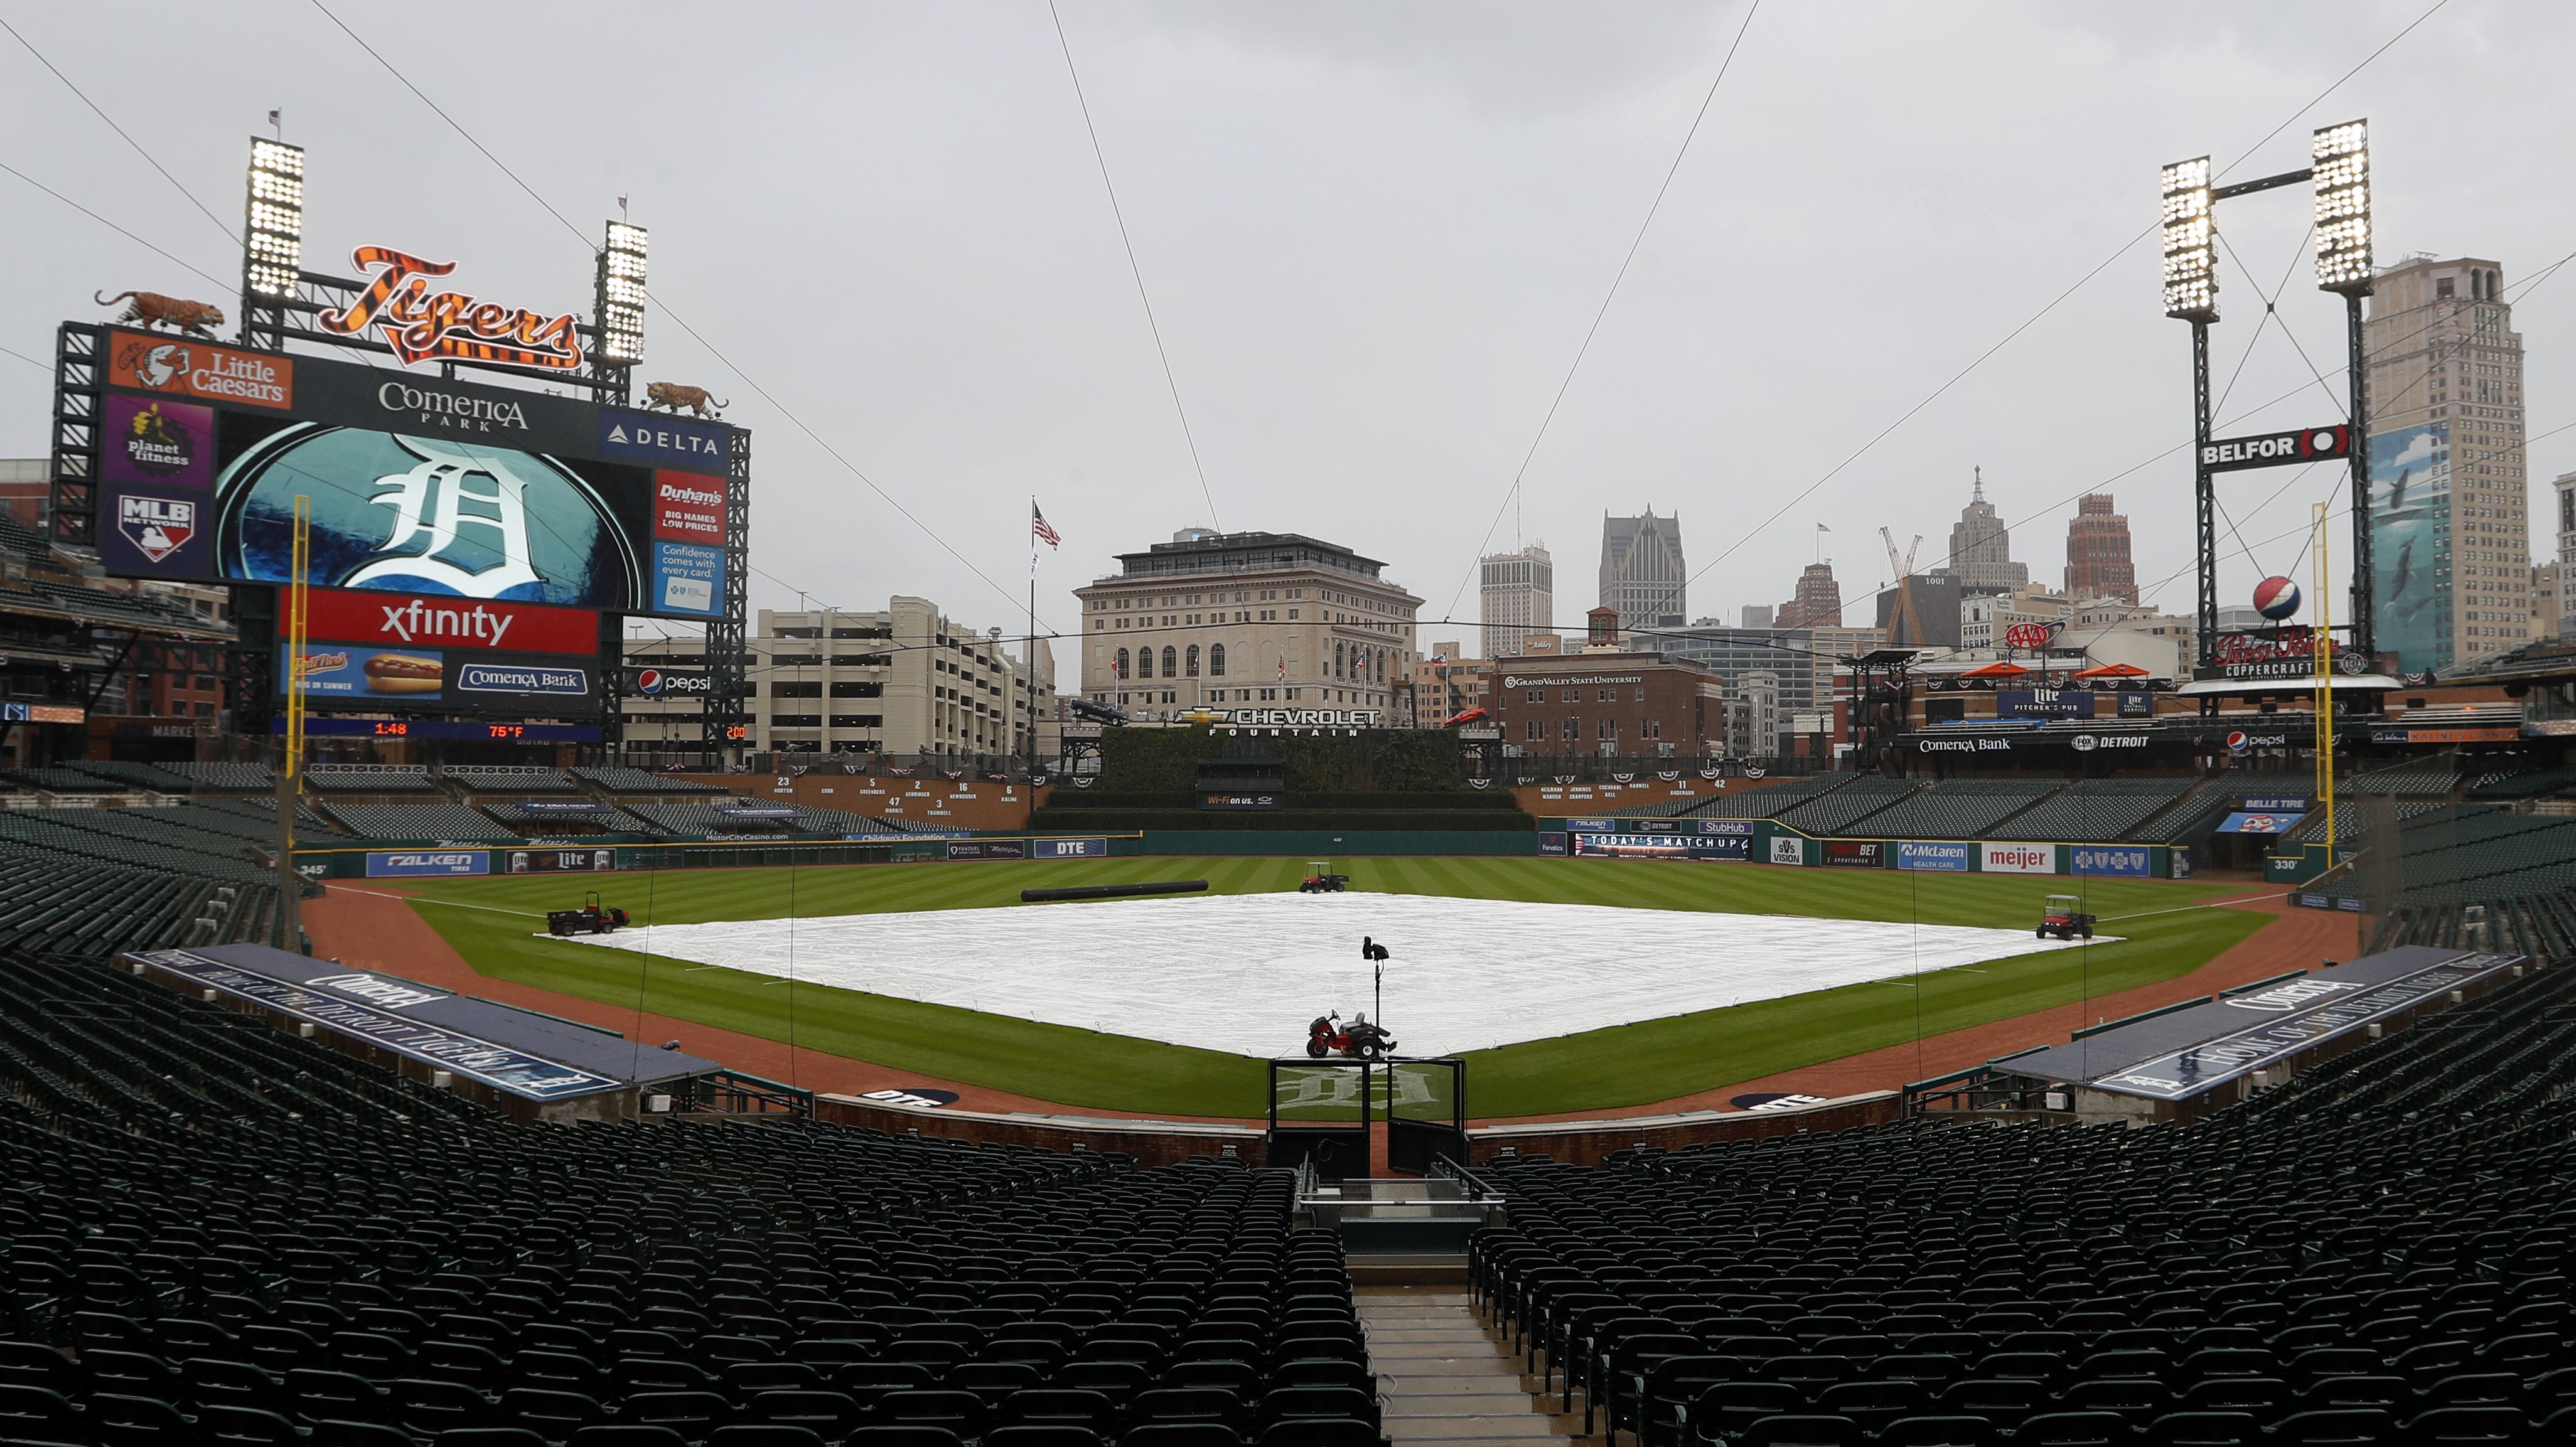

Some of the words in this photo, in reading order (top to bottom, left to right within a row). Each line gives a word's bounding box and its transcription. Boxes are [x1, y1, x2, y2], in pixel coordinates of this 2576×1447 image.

[318, 243, 584, 368] Tigers
[212, 352, 275, 383] Little
[191, 368, 284, 402] Caesars
[378, 382, 530, 430] Comerica
[421, 412, 490, 432] PARK
[127, 439, 180, 455] planet
[637, 428, 719, 456] DELTA
[2203, 437, 2295, 464] BELFOR
[134, 449, 189, 466] fitness
[660, 484, 723, 504] Dunham's
[124, 498, 191, 521] MLB
[123, 516, 190, 528] NETWORK
[665, 510, 682, 520] BIG
[684, 513, 716, 523] NAMES
[662, 519, 683, 528] LOW
[685, 521, 719, 533] PRICES
[662, 545, 716, 559] Confidence
[662, 557, 693, 567] comes
[695, 558, 716, 569] with
[662, 567, 689, 577] every
[690, 569, 713, 578] card.
[1925, 577, 1945, 585] 1001
[380, 599, 513, 646] xfinity
[2009, 624, 2044, 648] AAA
[1532, 641, 1552, 649] Ashley
[2214, 633, 2271, 666] PEPSI
[2226, 663, 2312, 677] COPPERCRAFT
[323, 681, 352, 690] SUMMER
[469, 670, 539, 688] Comerica
[542, 673, 577, 687] Bank
[665, 676, 711, 692] pepsi
[1571, 676, 1594, 685] STATE
[1594, 676, 1642, 685] UNIVERSITY
[2034, 688, 2059, 705] Lite
[2128, 695, 2142, 705] Lite
[1236, 709, 1380, 725] CHEVROLET
[153, 725, 199, 737] MARKET
[375, 722, 407, 735] 1:48
[489, 725, 523, 737] 75°F
[1209, 729, 1357, 737] FOUNTAIN
[1919, 740, 1976, 753] Comerica
[1978, 738, 2011, 750] Bank
[2100, 736, 2149, 748] DETROIT
[2248, 734, 2285, 747] pepsi
[777, 777, 790, 786] 23
[869, 778, 876, 787] 5
[915, 781, 921, 789] 2
[958, 782, 968, 791] 16
[1678, 780, 1687, 789] 11
[1714, 779, 1725, 788] 42
[1006, 786, 1012, 794] 6
[888, 797, 900, 806] 47
[936, 799, 942, 808] 3
[1208, 796, 1230, 804] Wi-Fi
[2245, 800, 2278, 808] BELLE
[1706, 822, 1745, 833] StubHub
[706, 833, 789, 841] MotorCityCasino.com
[1591, 835, 1653, 846] TODAY'S
[1663, 837, 1737, 848] MATCHUP
[1056, 841, 1085, 855] DTE
[1778, 840, 1795, 854] SVS
[1917, 845, 1964, 858] McLaren
[387, 855, 472, 866] FALKEN
[557, 852, 585, 868] Lite
[1773, 853, 1800, 863] VISION
[1990, 847, 2046, 870] meijer
[299, 865, 327, 875] 345'
[2274, 860, 2298, 870] 330'
[302, 1003, 417, 1041] DETROIT
[2187, 1037, 2290, 1067] HOME
[2267, 1022, 2317, 1039] OF
[2301, 1012, 2351, 1027] THE
[2341, 983, 2421, 1015] DETROIT
[862, 1090, 943, 1107] DTE
